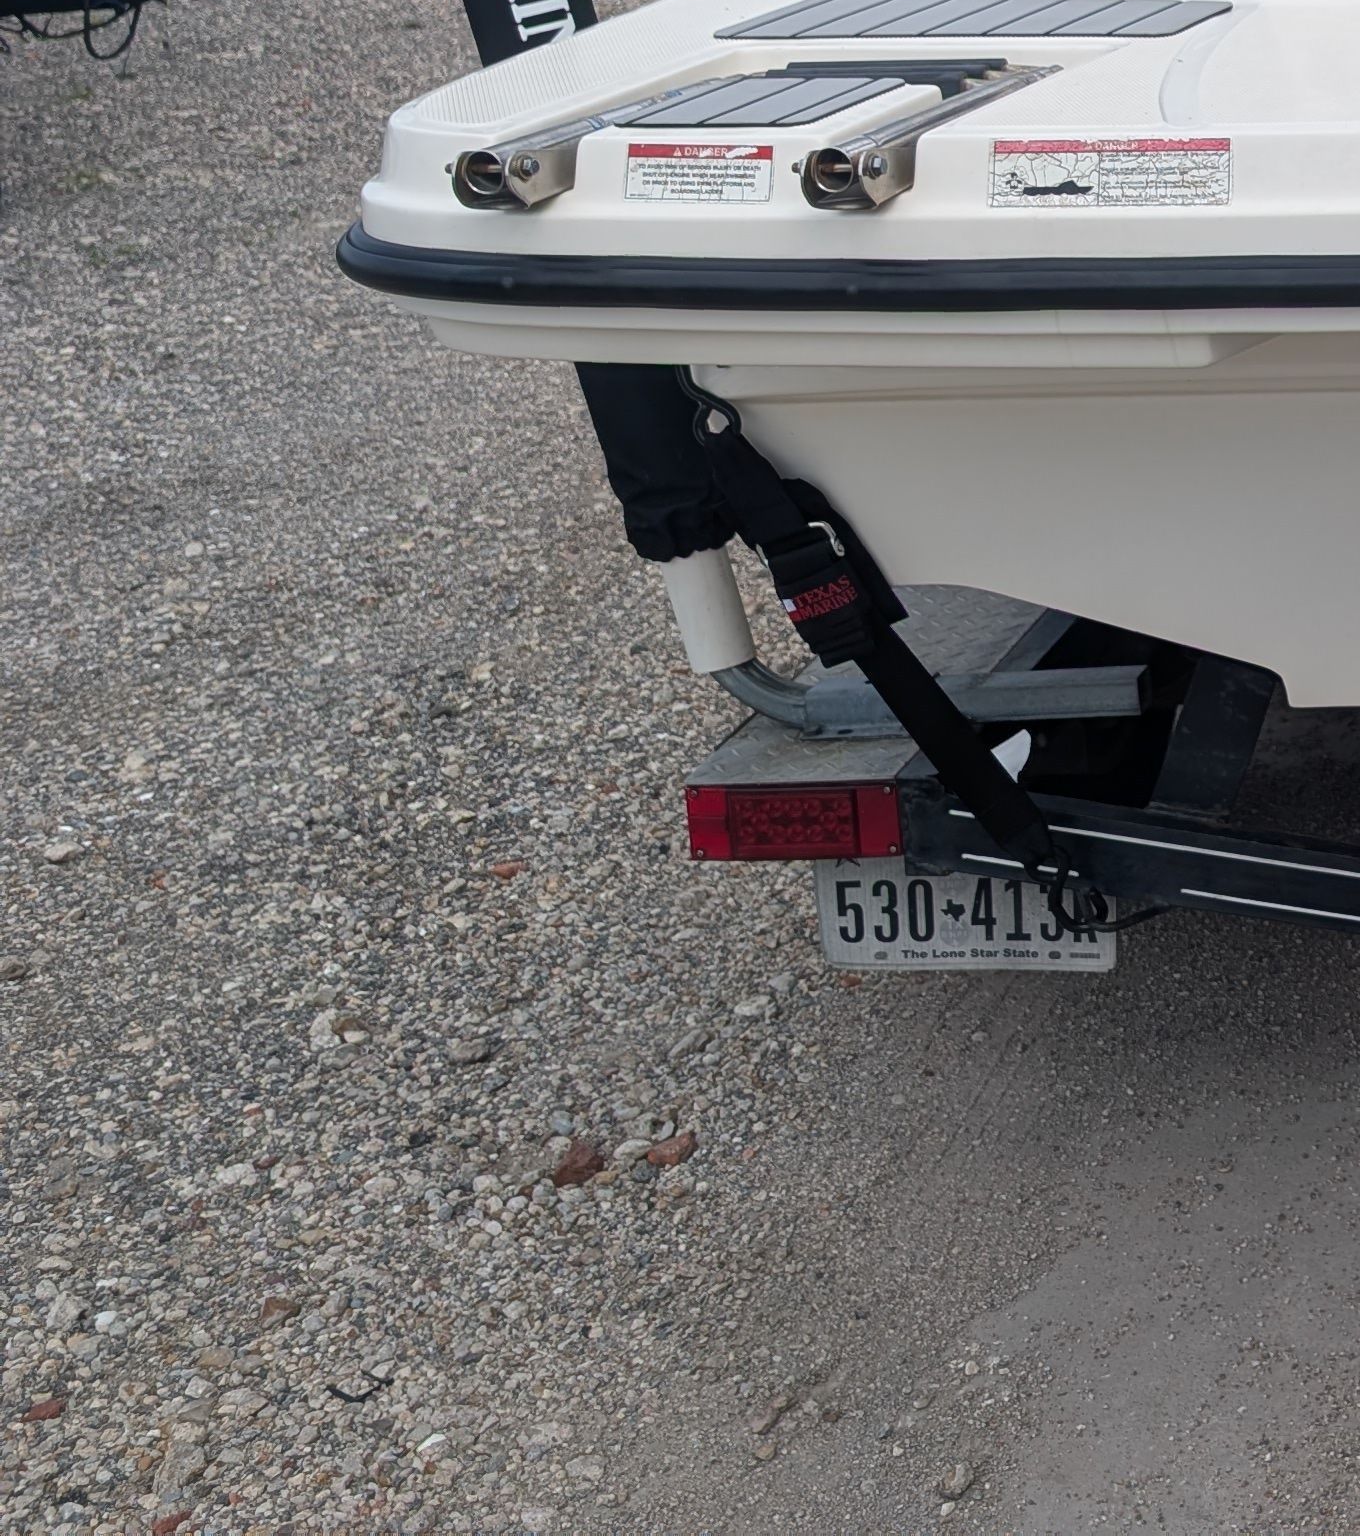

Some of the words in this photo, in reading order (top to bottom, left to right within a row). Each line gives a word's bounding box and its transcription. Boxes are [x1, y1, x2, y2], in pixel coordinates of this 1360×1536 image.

[793, 575, 850, 607] TEXAS
[800, 586, 859, 620] MARINE
[835, 879, 935, 943] 530
[901, 949, 929, 960] The
[931, 949, 967, 960] Lone
[969, 948, 1000, 959] Star
[1002, 947, 1040, 959] State
